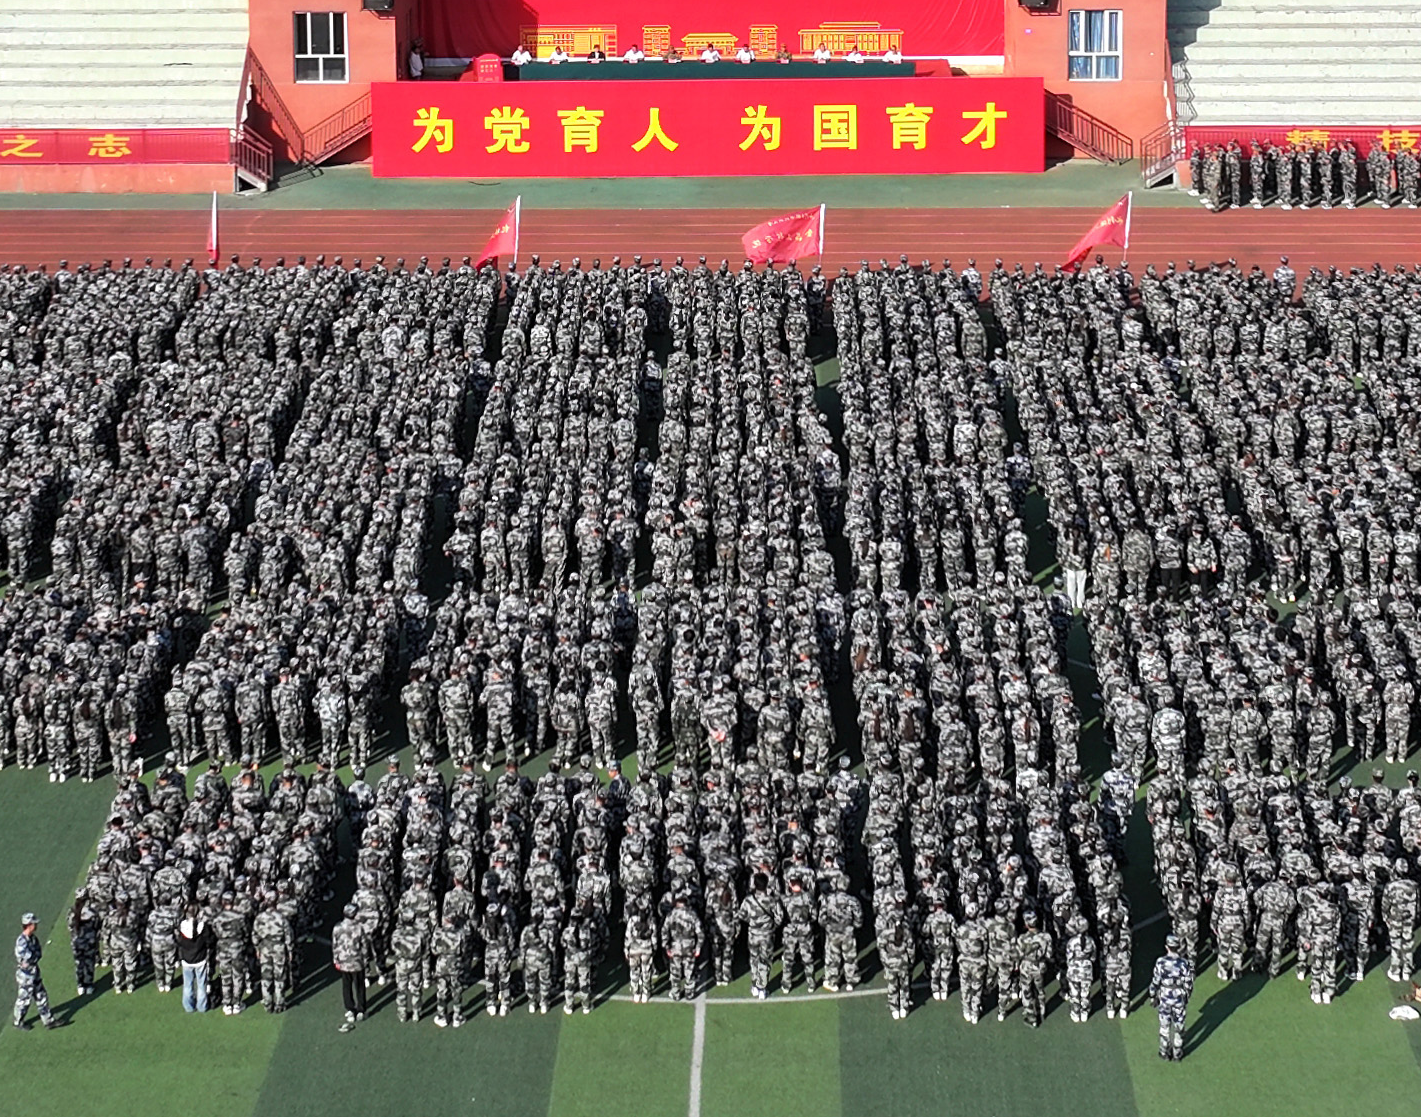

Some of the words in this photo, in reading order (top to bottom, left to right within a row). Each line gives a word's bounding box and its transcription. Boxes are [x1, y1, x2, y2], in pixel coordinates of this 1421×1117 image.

[411, 106, 679, 154] 为党育人
[738, 102, 1008, 152] 为国育才
